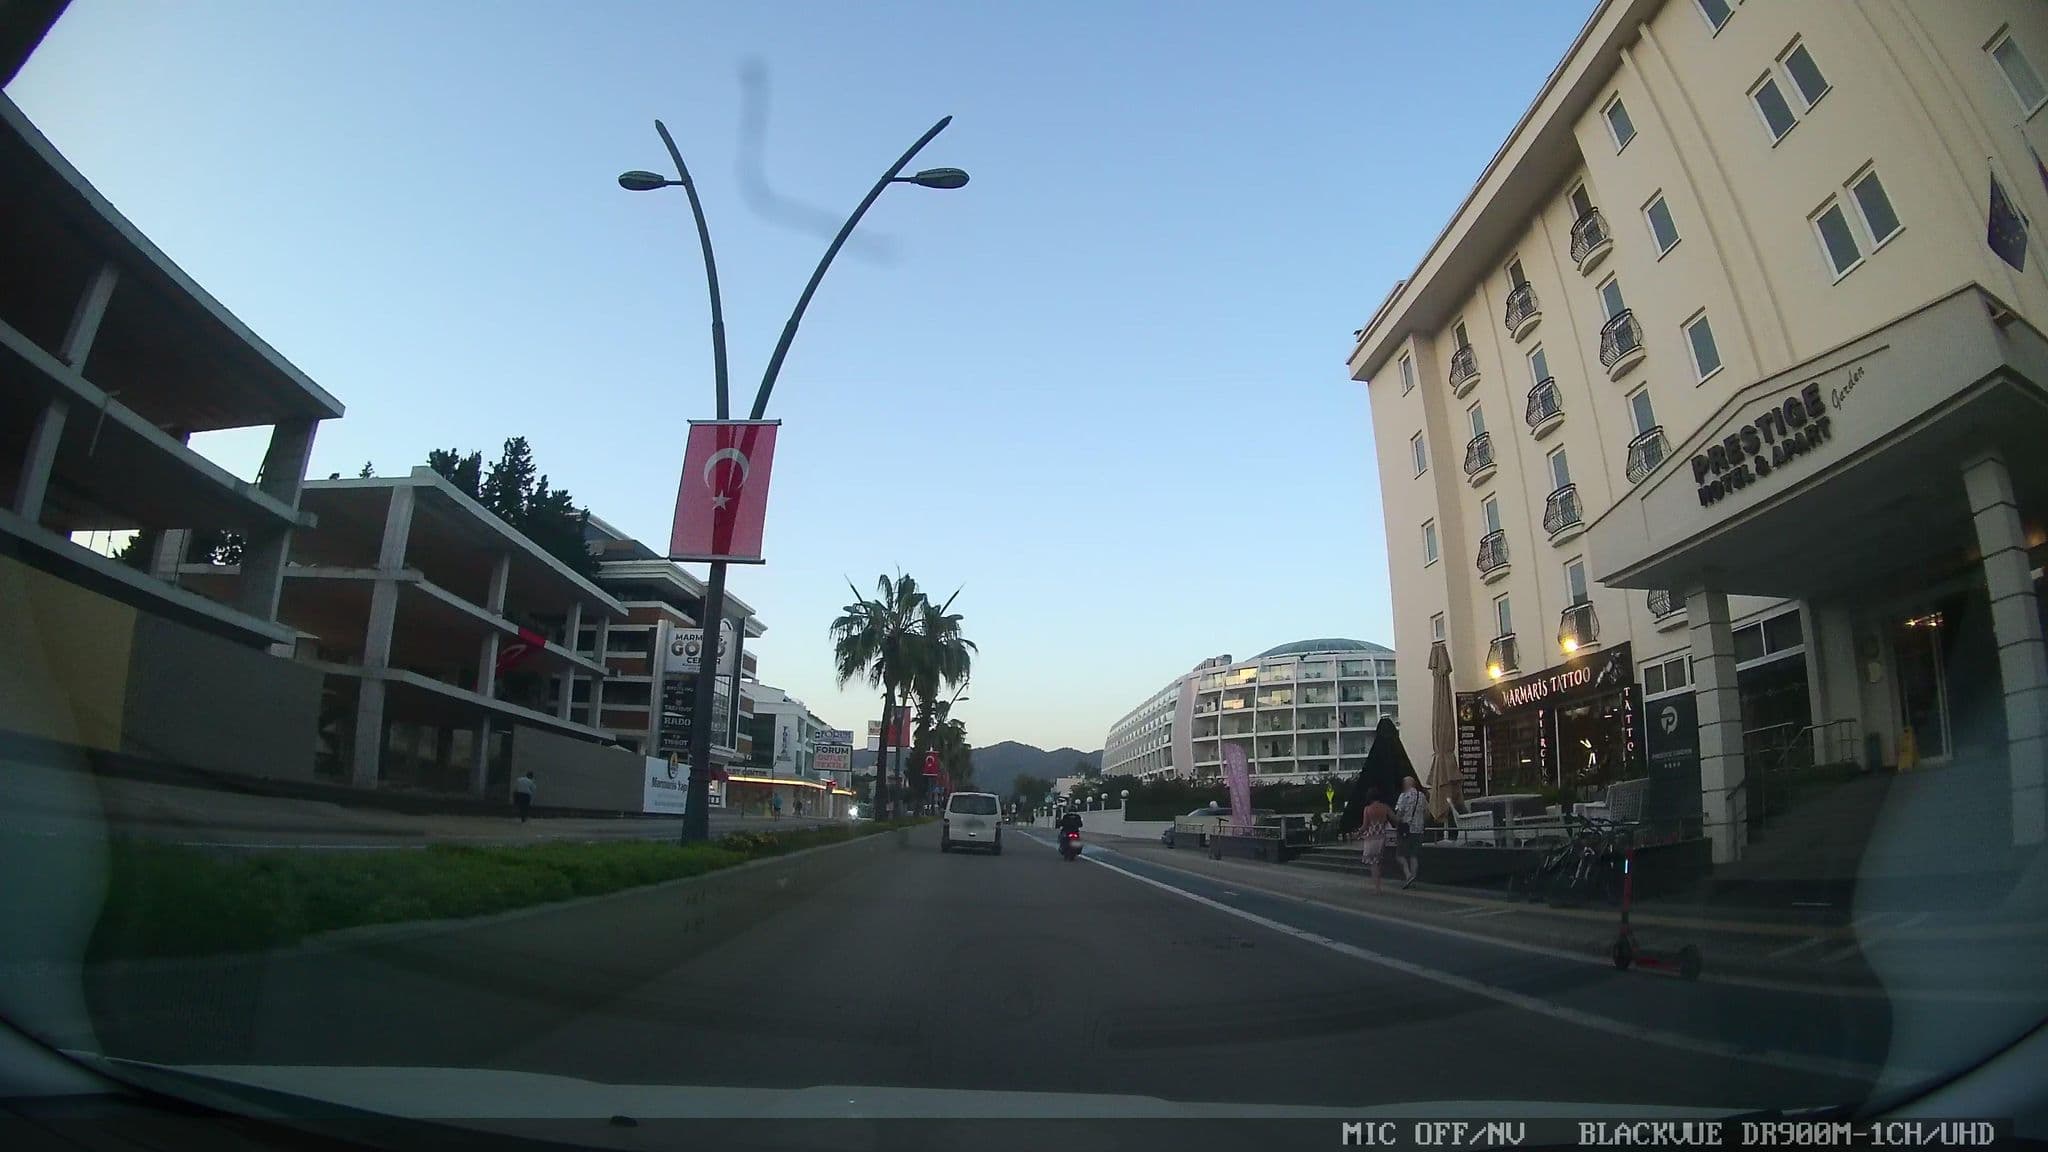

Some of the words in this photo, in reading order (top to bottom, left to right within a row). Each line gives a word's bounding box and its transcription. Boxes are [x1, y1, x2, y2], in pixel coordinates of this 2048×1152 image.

[1832, 366, 1865, 410] Garden
[1691, 382, 1826, 485] PRESTIGE
[1697, 464, 1756, 507] HOTEL
[1754, 454, 1772, 477] &
[1772, 415, 1831, 469] APART
[671, 640, 727, 658] GOD
[1550, 666, 1591, 693] TATTOO
[663, 717, 692, 727] RADO
[815, 745, 849, 755] FORUM
